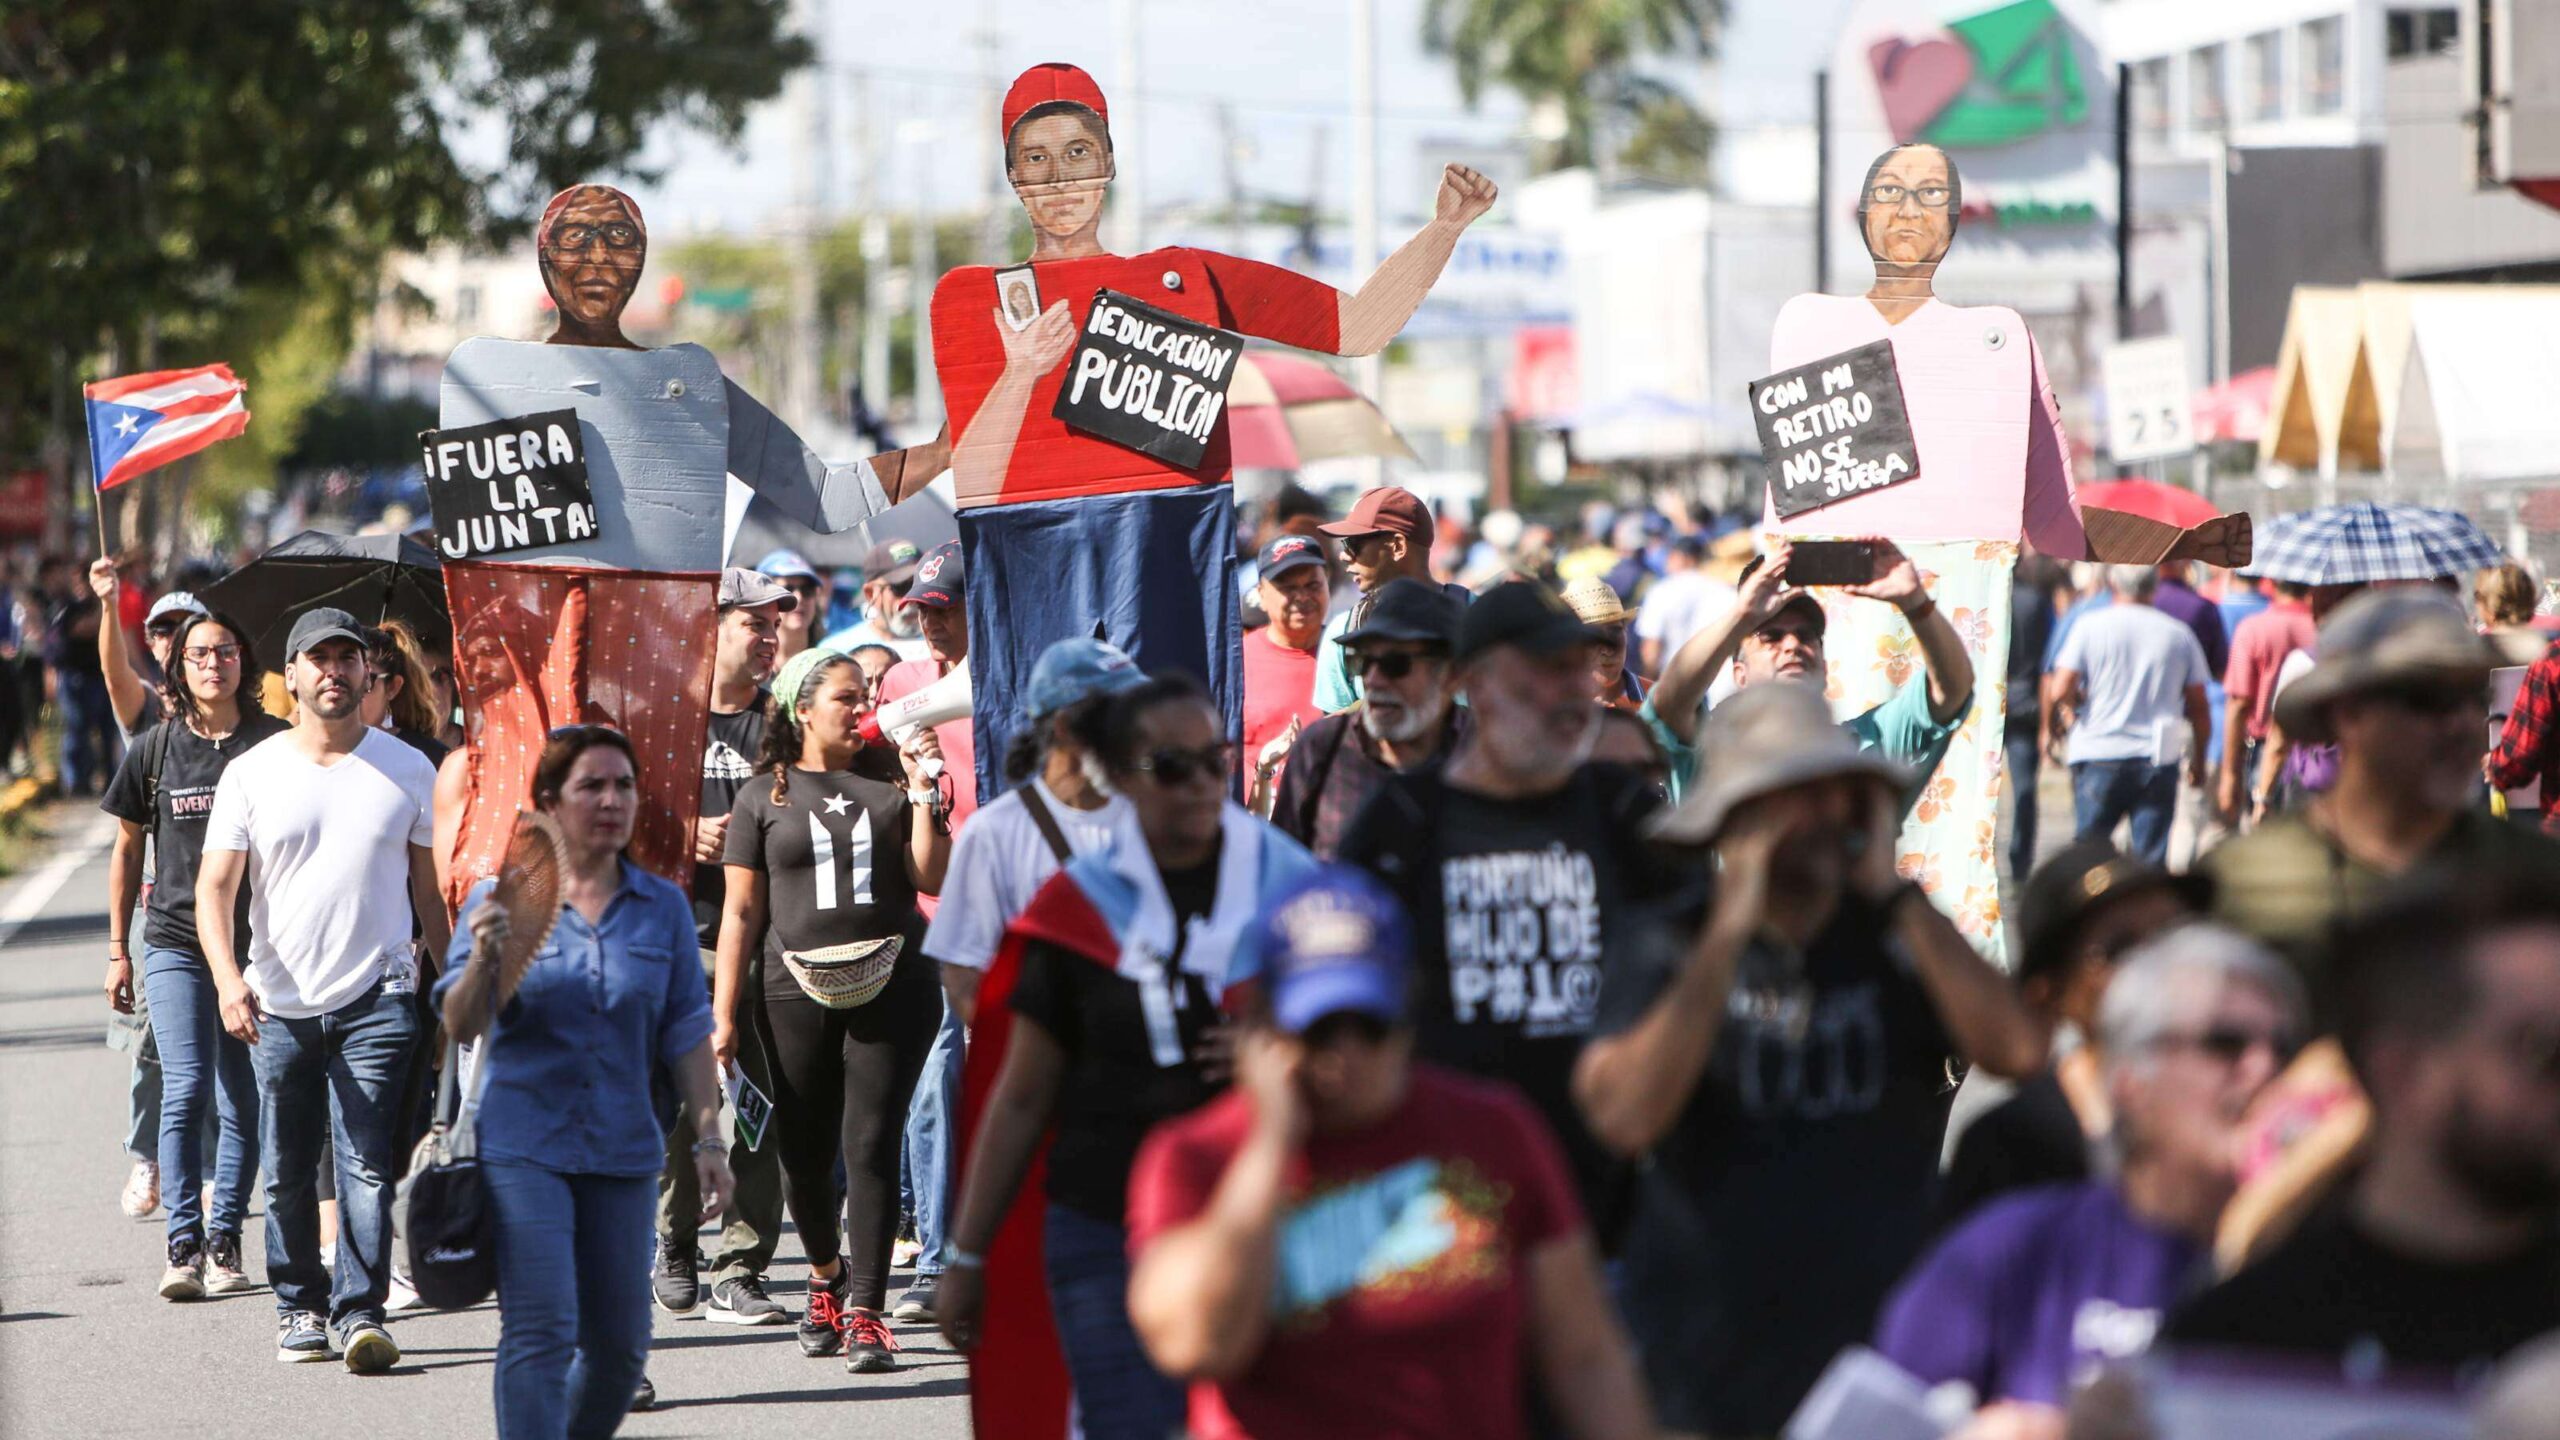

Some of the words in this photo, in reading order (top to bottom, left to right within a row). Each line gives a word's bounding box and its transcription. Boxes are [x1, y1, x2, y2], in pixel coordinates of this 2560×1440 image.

[1088, 298, 1232, 381] ¡EDUCACIÓN
[1070, 348, 1224, 444] PÚBLICA!
[1759, 376, 1808, 414] CON
[1821, 363, 1854, 396] MI
[1773, 392, 1872, 448] RETIRO
[424, 424, 574, 481] ¡FUERA
[1782, 449, 1822, 490] NO
[1821, 435, 1858, 475] SE
[1824, 453, 1908, 497] JUEGA
[489, 475, 539, 511] LA
[441, 502, 597, 559] JUNTA!
[171, 794, 214, 815] JUVENT
[1441, 840, 1597, 912] FORTUÑO
[1446, 906, 1542, 963] HIJO
[1547, 901, 1602, 961] DE
